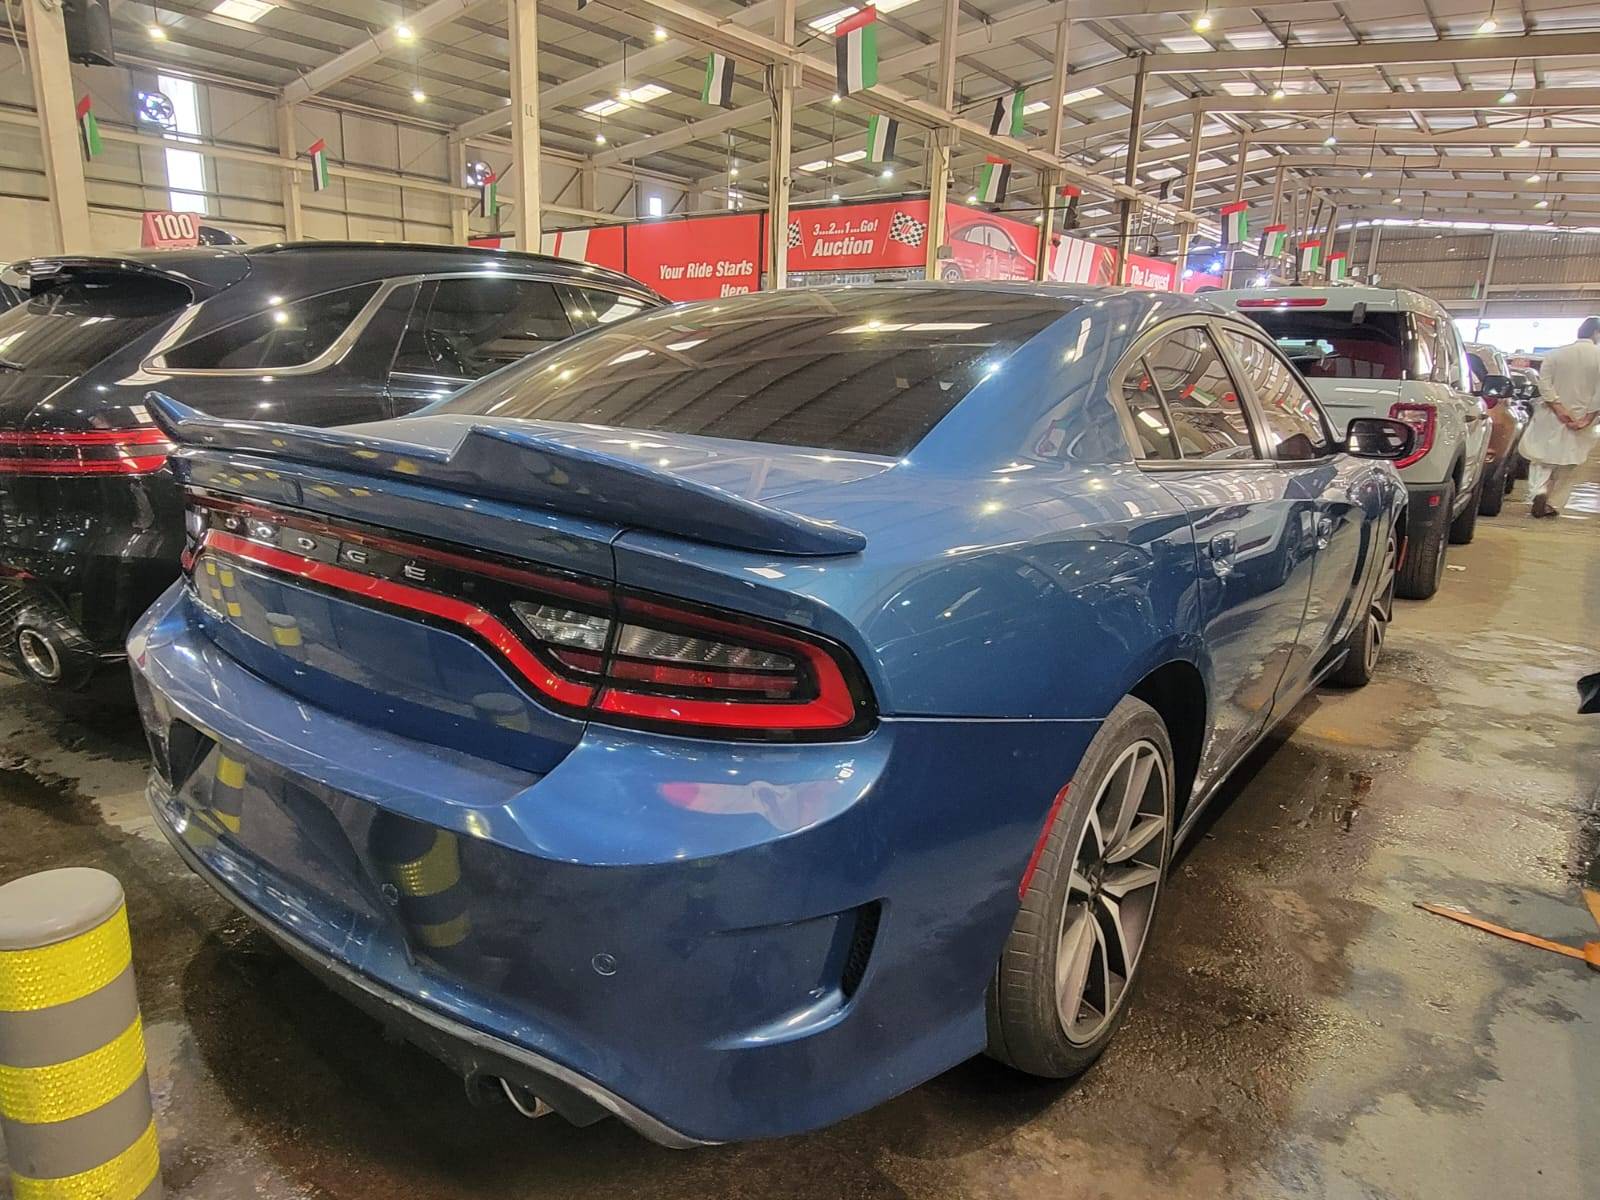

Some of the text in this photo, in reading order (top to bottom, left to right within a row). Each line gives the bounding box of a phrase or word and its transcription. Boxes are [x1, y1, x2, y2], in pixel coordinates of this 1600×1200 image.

[154, 213, 194, 240] 100
[811, 236, 874, 257] Auction
[660, 259, 753, 280] Your Ride Starts
[1130, 264, 1170, 291] The Largest
[720, 283, 749, 298] Here
[224, 517, 427, 582] DODGE
